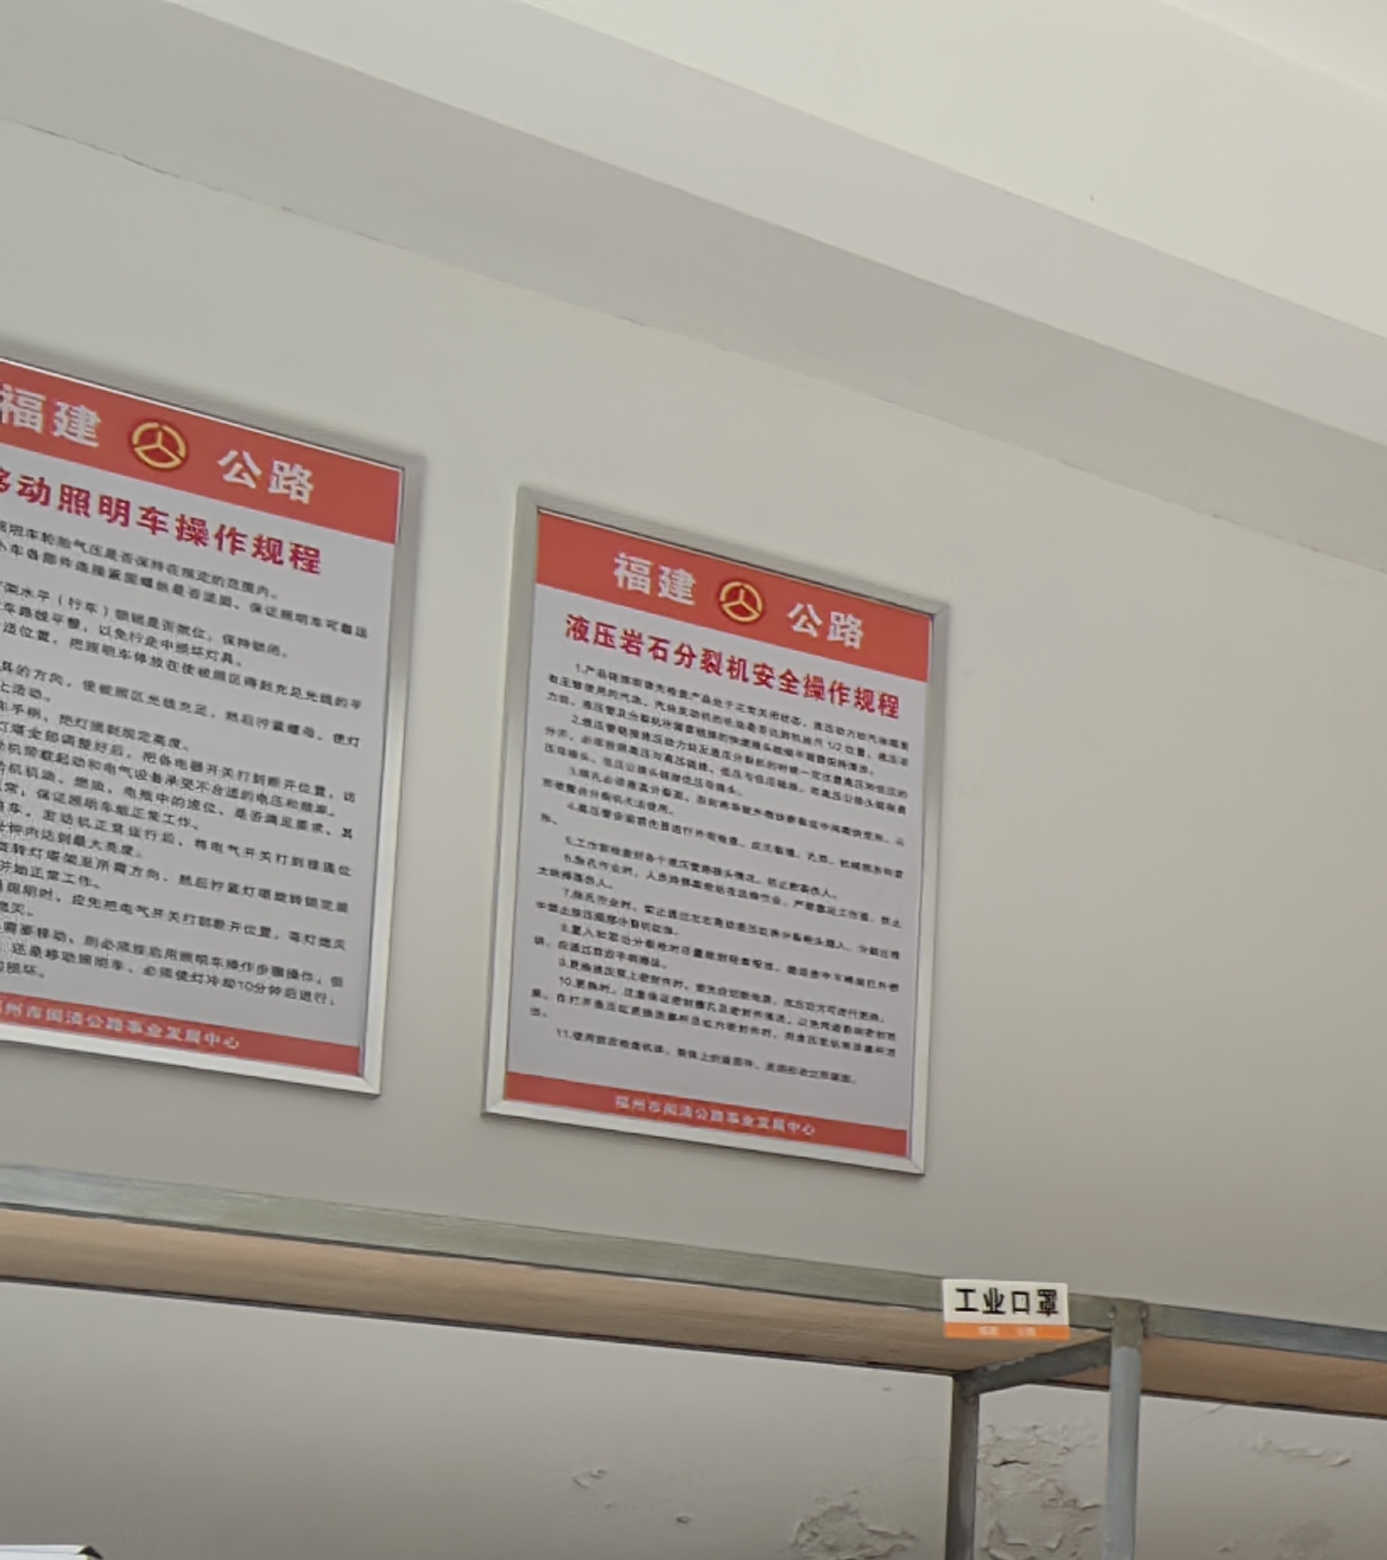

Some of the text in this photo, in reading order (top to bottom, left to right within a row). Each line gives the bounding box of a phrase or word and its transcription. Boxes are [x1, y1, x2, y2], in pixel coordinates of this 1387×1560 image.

[0, 384, 314, 505] 福建 公路
[613, 552, 864, 649] 福建 公路
[564, 613, 902, 722] 液压岩石分裂机安全操作规程
[0, 999, 240, 1050] 州市闽清公路事业发展中心
[954, 1287, 1060, 1317] 工业口罩
